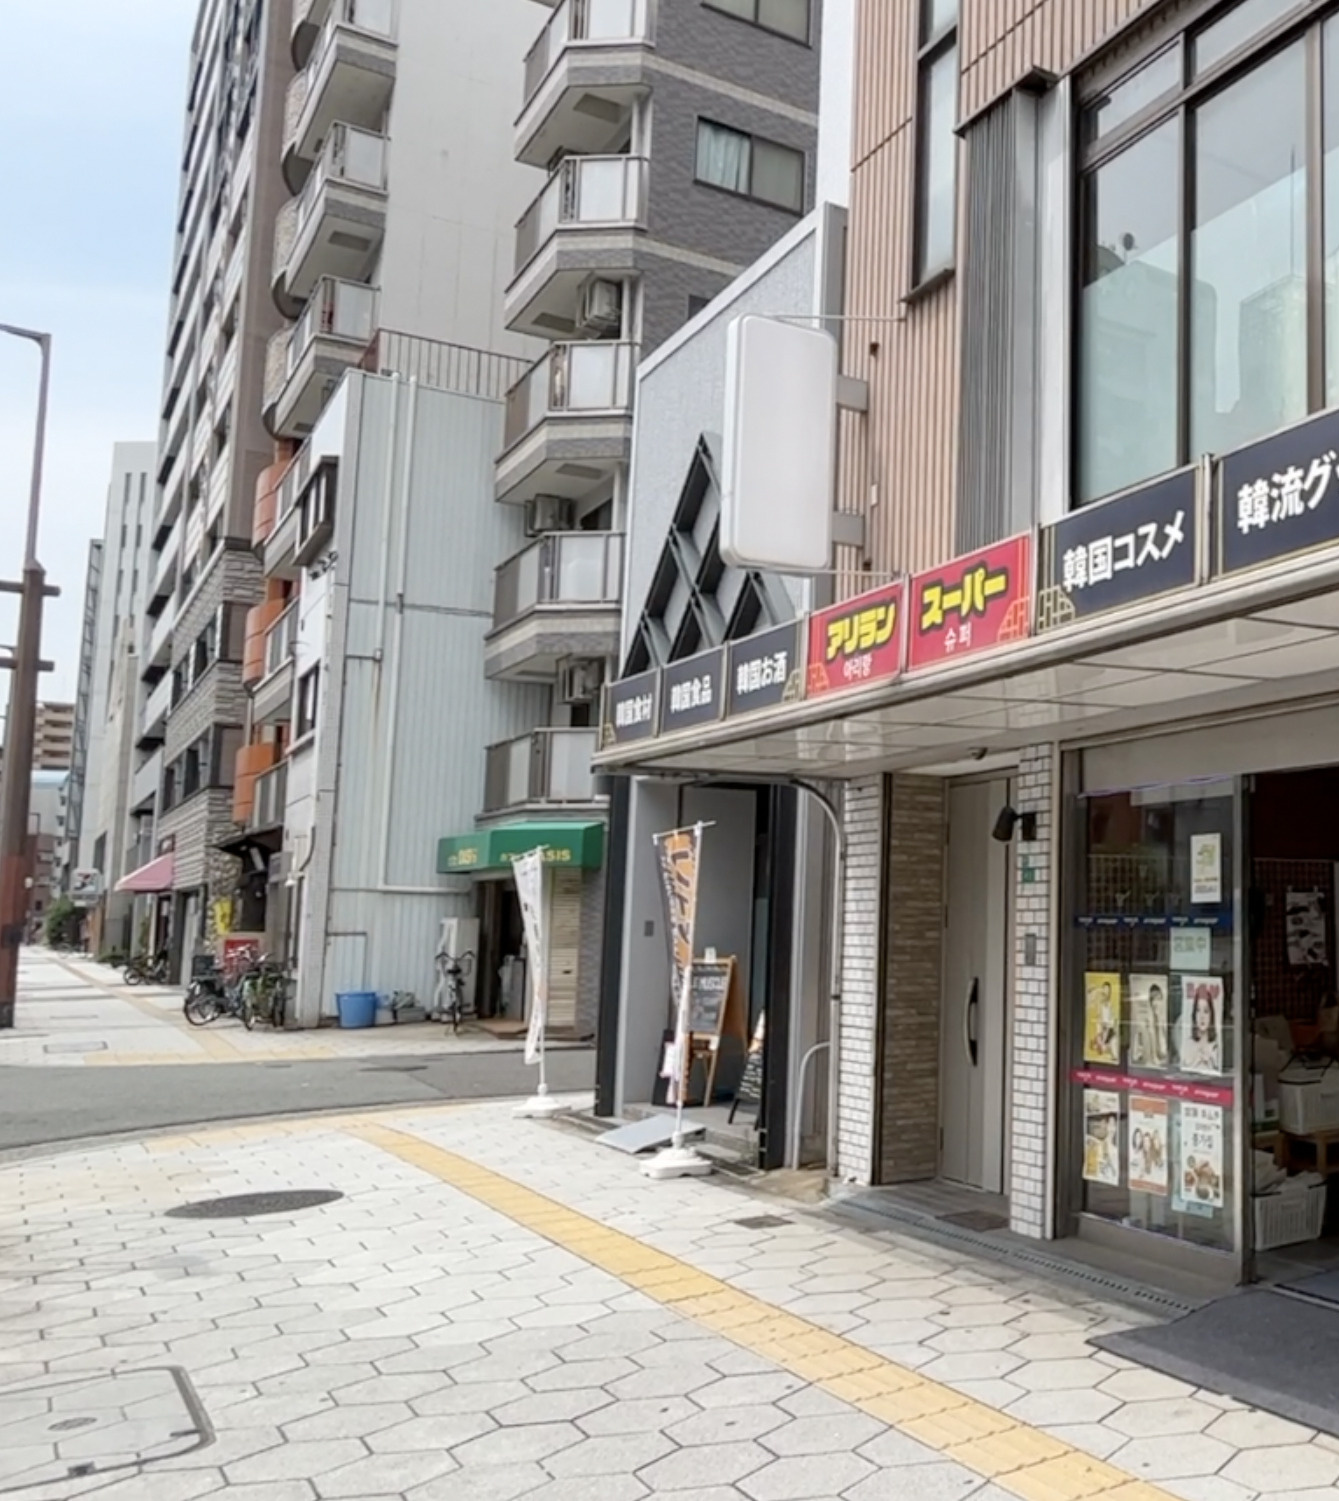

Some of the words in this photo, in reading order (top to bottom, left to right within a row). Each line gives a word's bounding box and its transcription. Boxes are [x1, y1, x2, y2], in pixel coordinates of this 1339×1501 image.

[1062, 510, 1186, 593] 韓国コスメ
[920, 566, 1008, 631] スーパー
[826, 602, 897, 661] アリラン
[736, 650, 787, 696] 韓国お酒
[843, 653, 872, 679] 아리랑
[670, 674, 712, 713] 韓国食品
